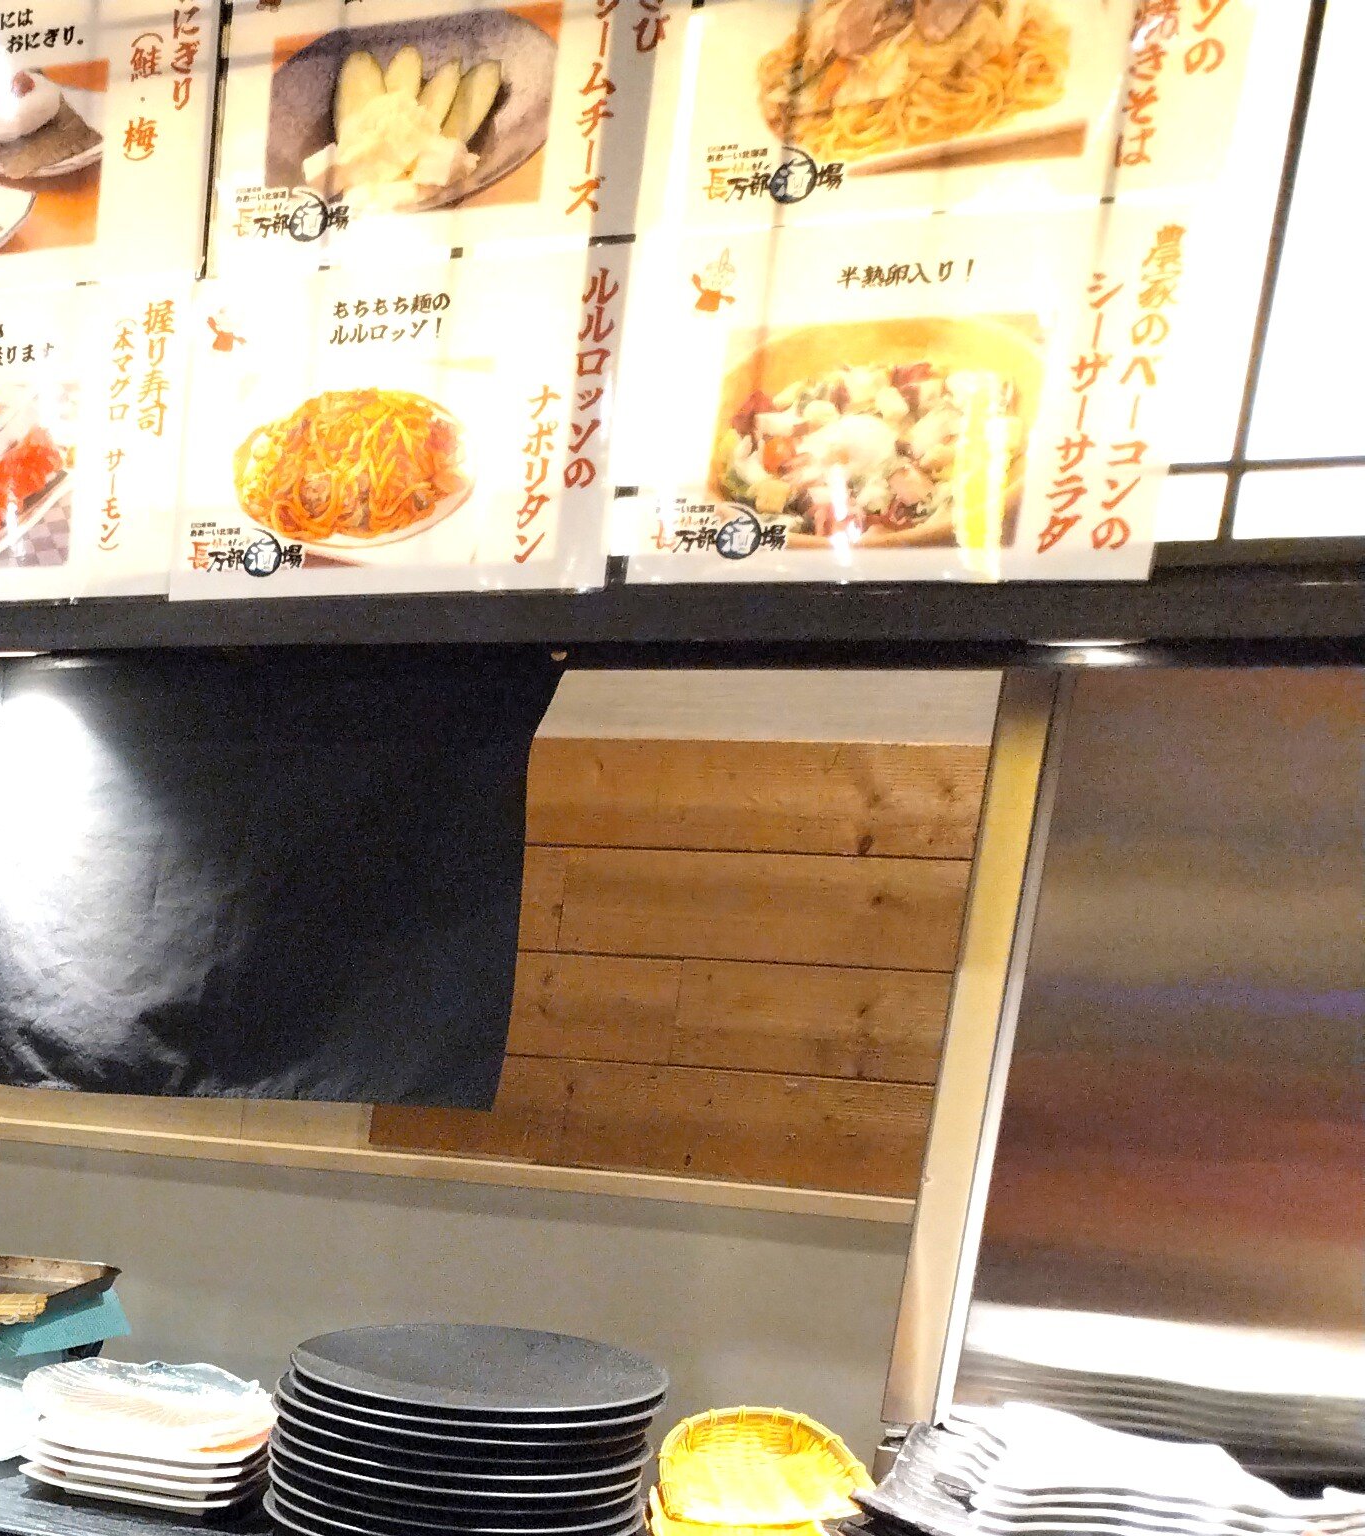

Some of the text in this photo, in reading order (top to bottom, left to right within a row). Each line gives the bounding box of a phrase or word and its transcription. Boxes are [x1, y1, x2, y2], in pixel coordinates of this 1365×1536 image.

[171, 0, 201, 111] にぎり
[333, 292, 451, 321] もちもち麺の
[836, 257, 977, 291] 半熟卵入り!
[138, 300, 176, 438] 握り寿司
[1036, 272, 1125, 556] シーザーサラダ
[1091, 224, 1189, 550] 農家のベーコンの
[514, 383, 562, 565] ナポリタン
